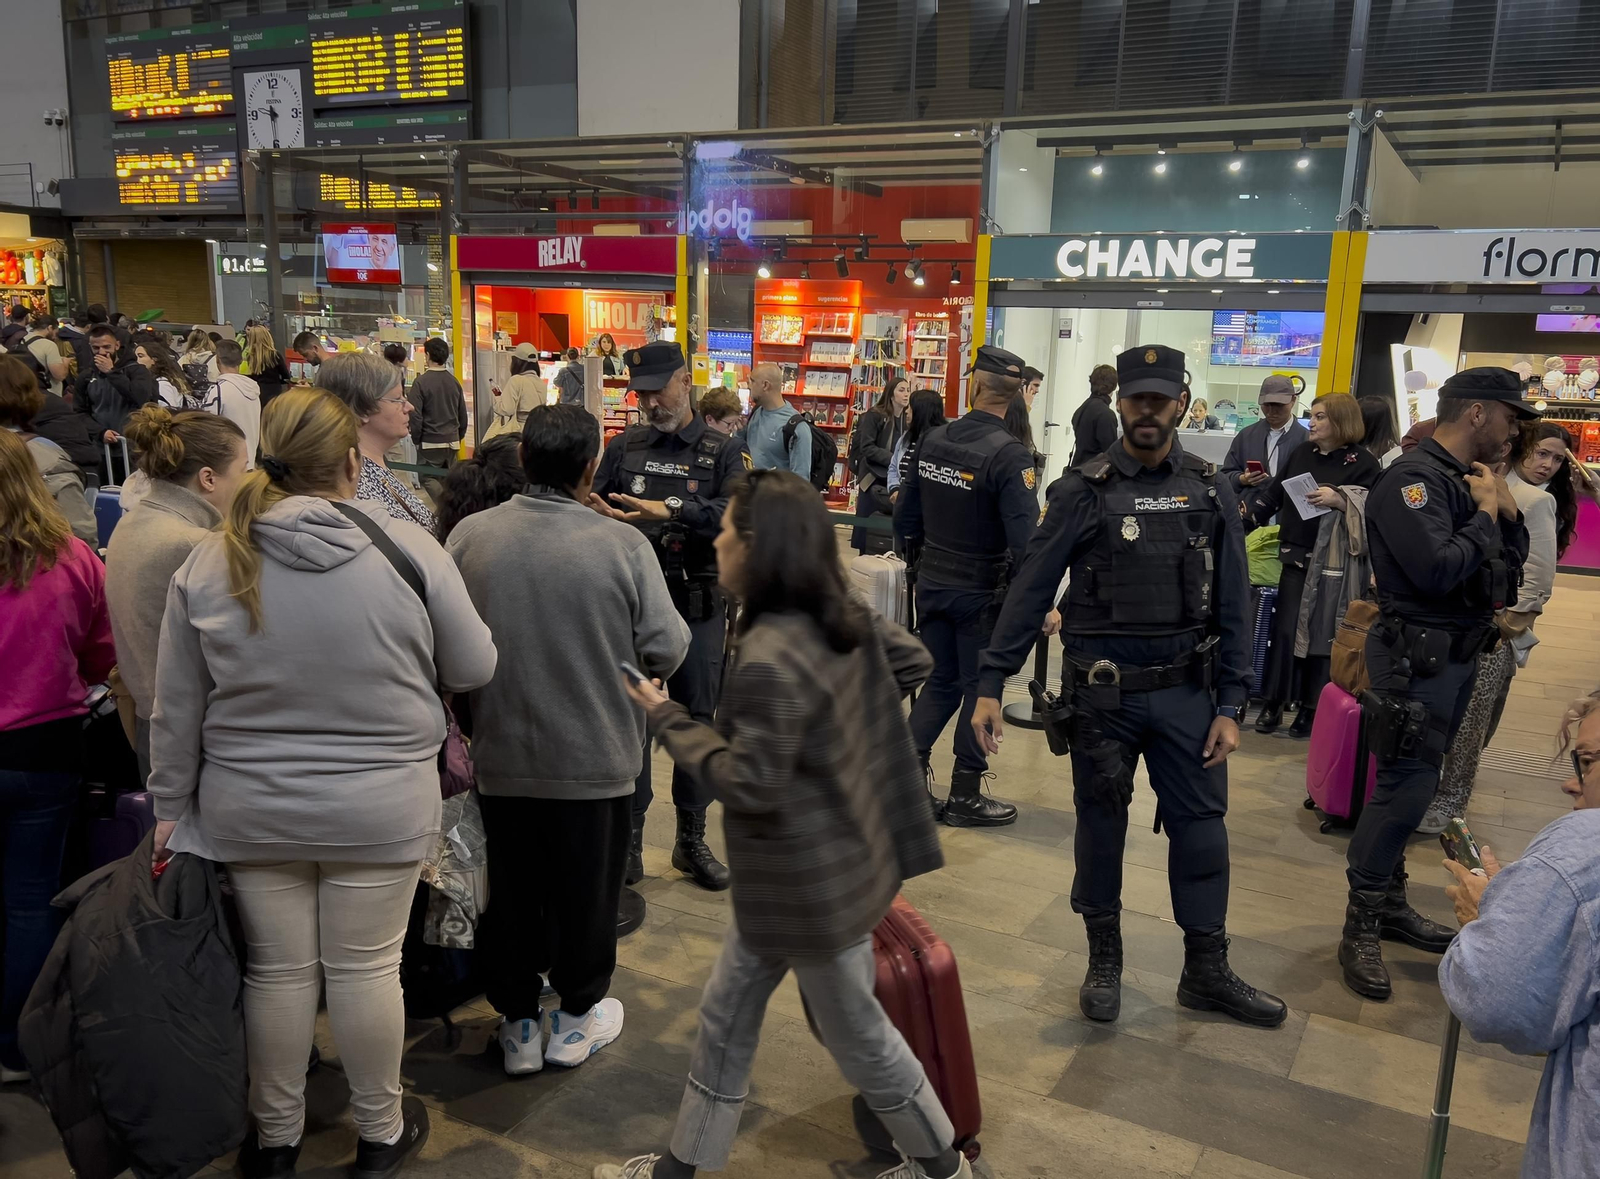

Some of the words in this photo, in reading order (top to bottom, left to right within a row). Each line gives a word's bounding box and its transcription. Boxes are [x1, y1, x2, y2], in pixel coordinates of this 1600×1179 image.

[267, 78, 278, 89] 12
[251, 110, 258, 120] 9
[291, 108, 298, 118] 3
[273, 139, 280, 148] 6
[538, 236, 582, 267] RELAY
[1482, 237, 1600, 277] florm
[1056, 238, 1256, 277] CHANGE
[589, 300, 650, 330] ¡HOLA
[645, 466, 689, 476] NACIONAL
[919, 460, 961, 478] POLICIA
[919, 469, 972, 490] NACIONAL
[1135, 496, 1177, 504] POLICIA
[1135, 502, 1190, 510] NACIONAL
